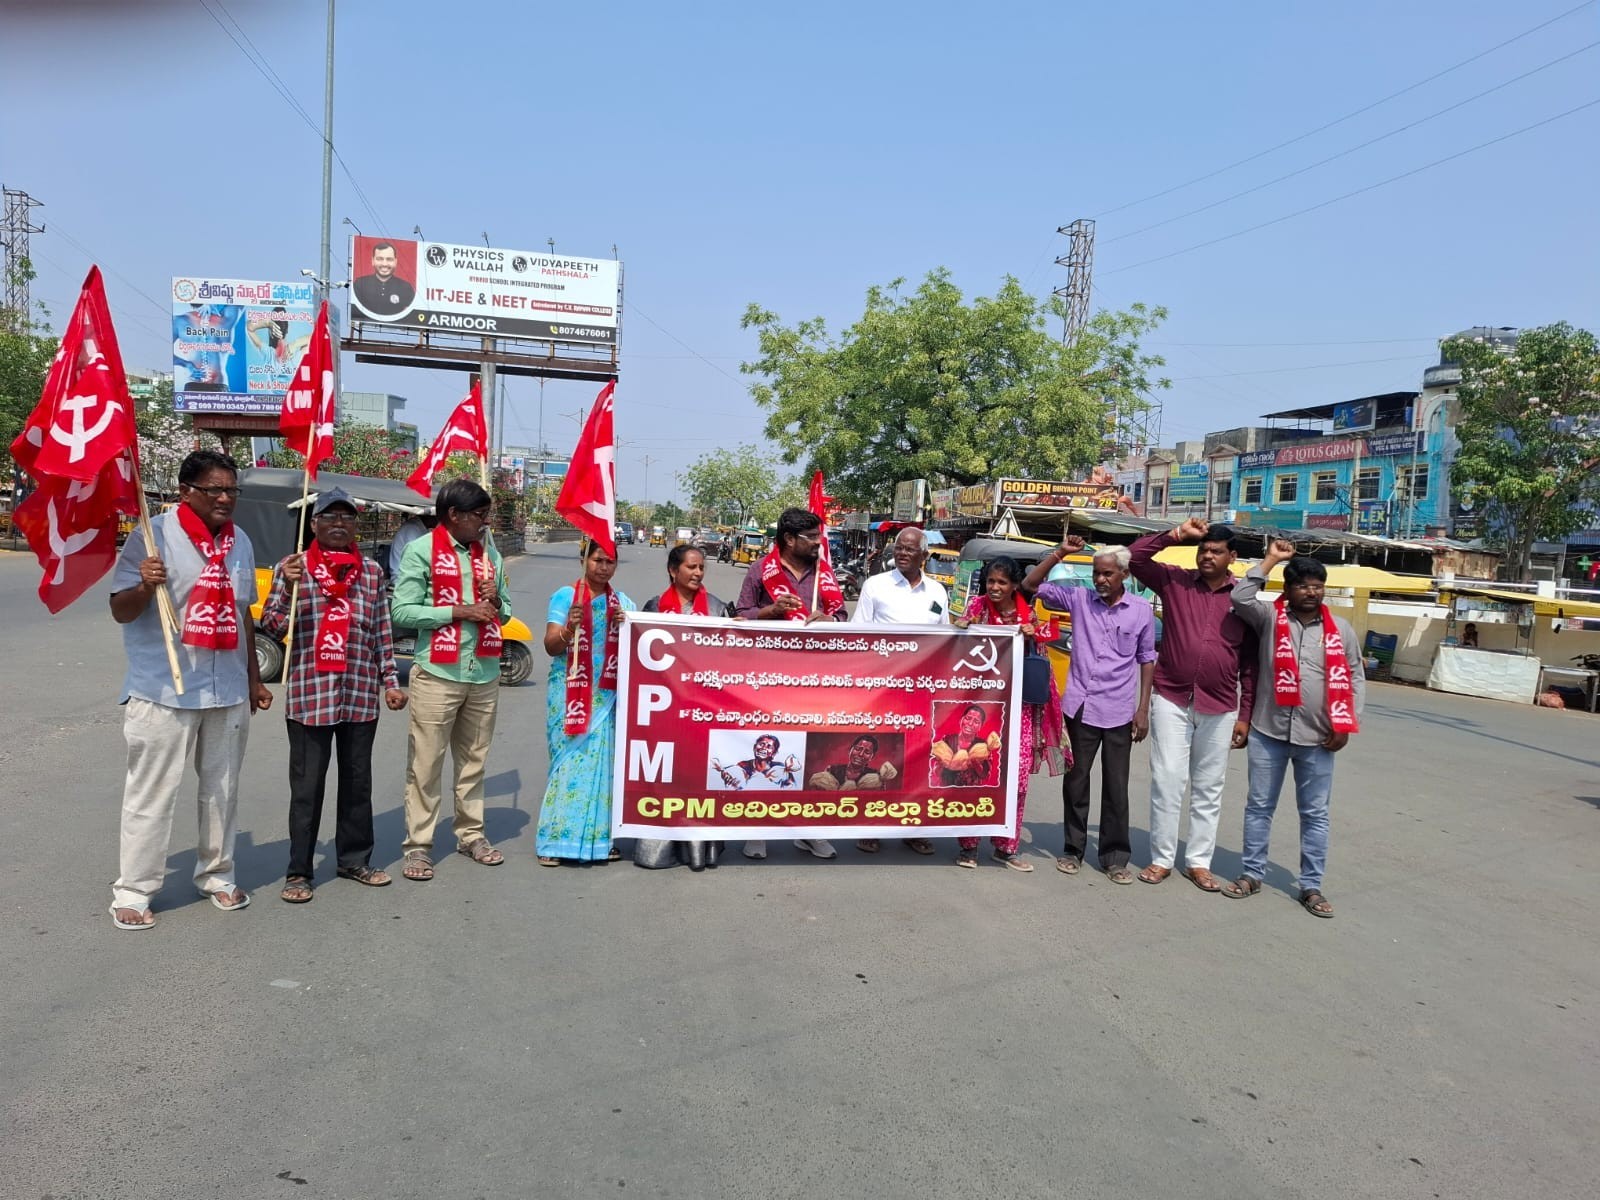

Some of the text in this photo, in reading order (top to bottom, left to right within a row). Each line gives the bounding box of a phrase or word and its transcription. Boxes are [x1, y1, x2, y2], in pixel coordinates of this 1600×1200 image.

[453, 247, 504, 262] PHYSICS
[453, 259, 503, 273] WALLAH
[530, 257, 598, 272] VIDYAPEETH
[541, 267, 589, 279] PATHSHALA
[489, 278, 509, 286] SCHOOL
[509, 280, 540, 289] INTEGRATED
[426, 288, 527, 309] IIT-JEE & NEET
[428, 314, 497, 330] ARMOOR
[186, 327, 229, 337] Back Pain
[249, 381, 265, 389] Neck
[1295, 441, 1362, 461] LOTUS GRAN
[1003, 481, 1052, 493] GOLDEN
[694, 632, 724, 647] రెండు
[725, 634, 754, 648] నెలల
[755, 636, 803, 650] పసికందు
[805, 638, 868, 652] హంతకులను
[320, 652, 345, 661] CPI(M)
[916, 675, 947, 693] చర్యలు
[691, 708, 714, 722] కుల
[637, 796, 716, 819] CPM
[721, 797, 859, 819] ఆదిలాబాద్
[864, 800, 922, 825] జిల్లా
